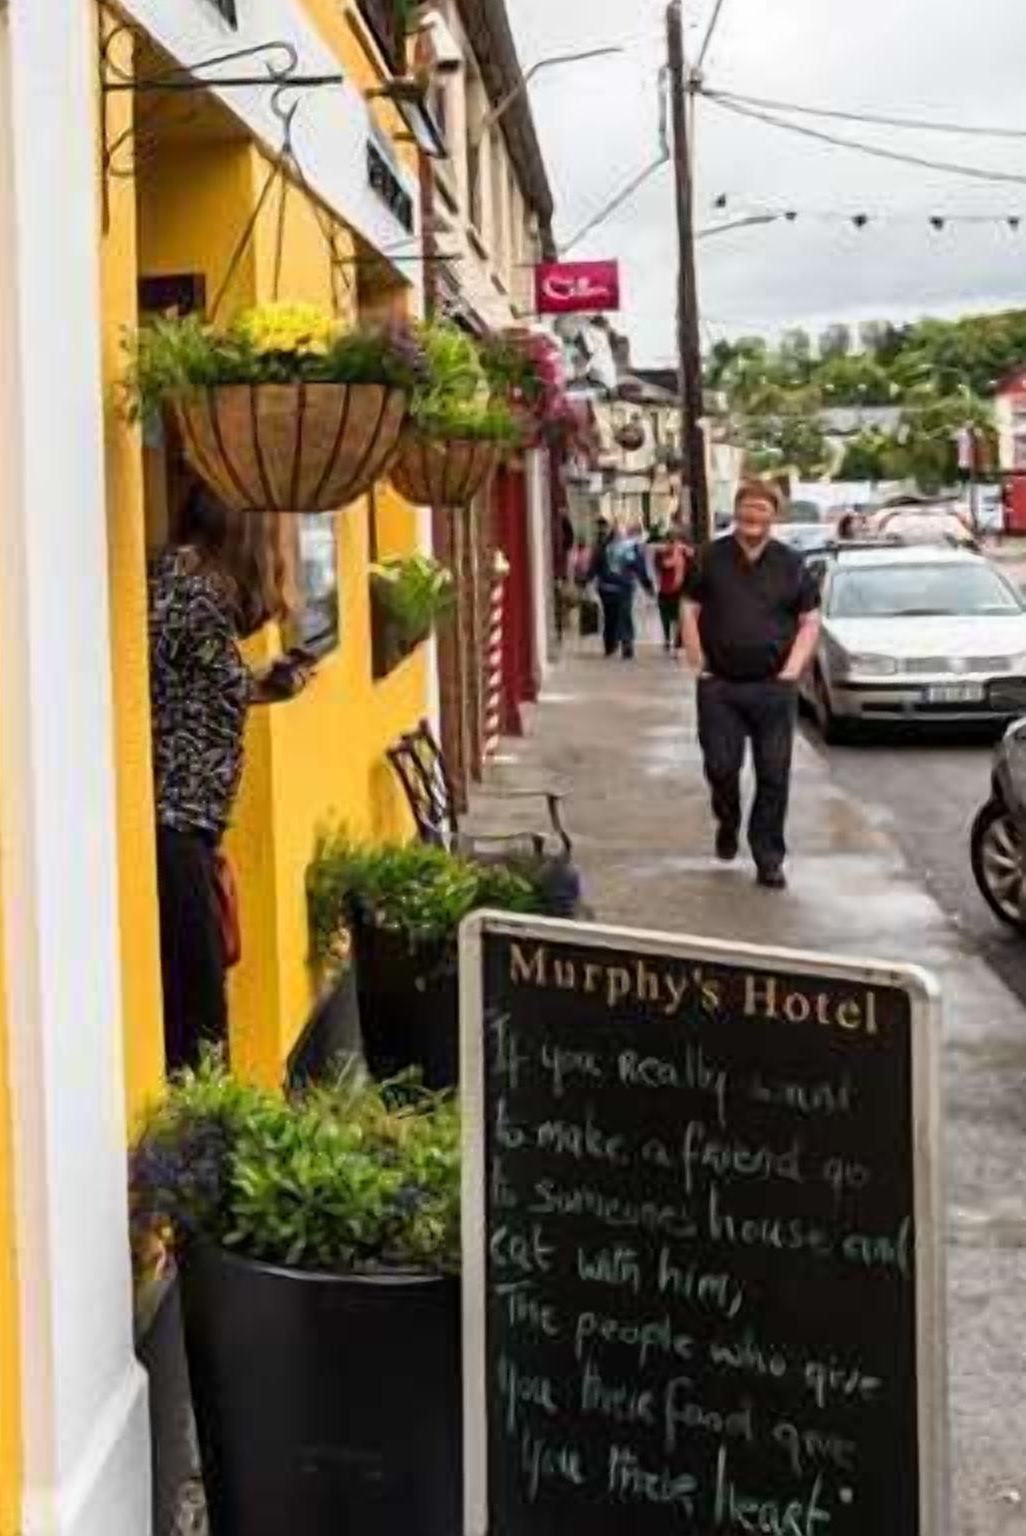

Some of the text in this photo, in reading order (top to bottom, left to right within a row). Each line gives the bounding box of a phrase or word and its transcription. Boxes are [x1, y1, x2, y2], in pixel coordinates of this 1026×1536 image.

[510, 944, 878, 1035] Murphy's Hotel
[491, 1012, 528, 1088] If
[542, 1042, 602, 1097] you
[537, 1098, 628, 1163] make
[641, 1136, 672, 1166] a
[710, 1182, 831, 1254] house
[577, 1247, 641, 1294] with
[575, 1310, 695, 1368] people
[710, 1330, 786, 1376] who
[499, 1353, 557, 1433] you
